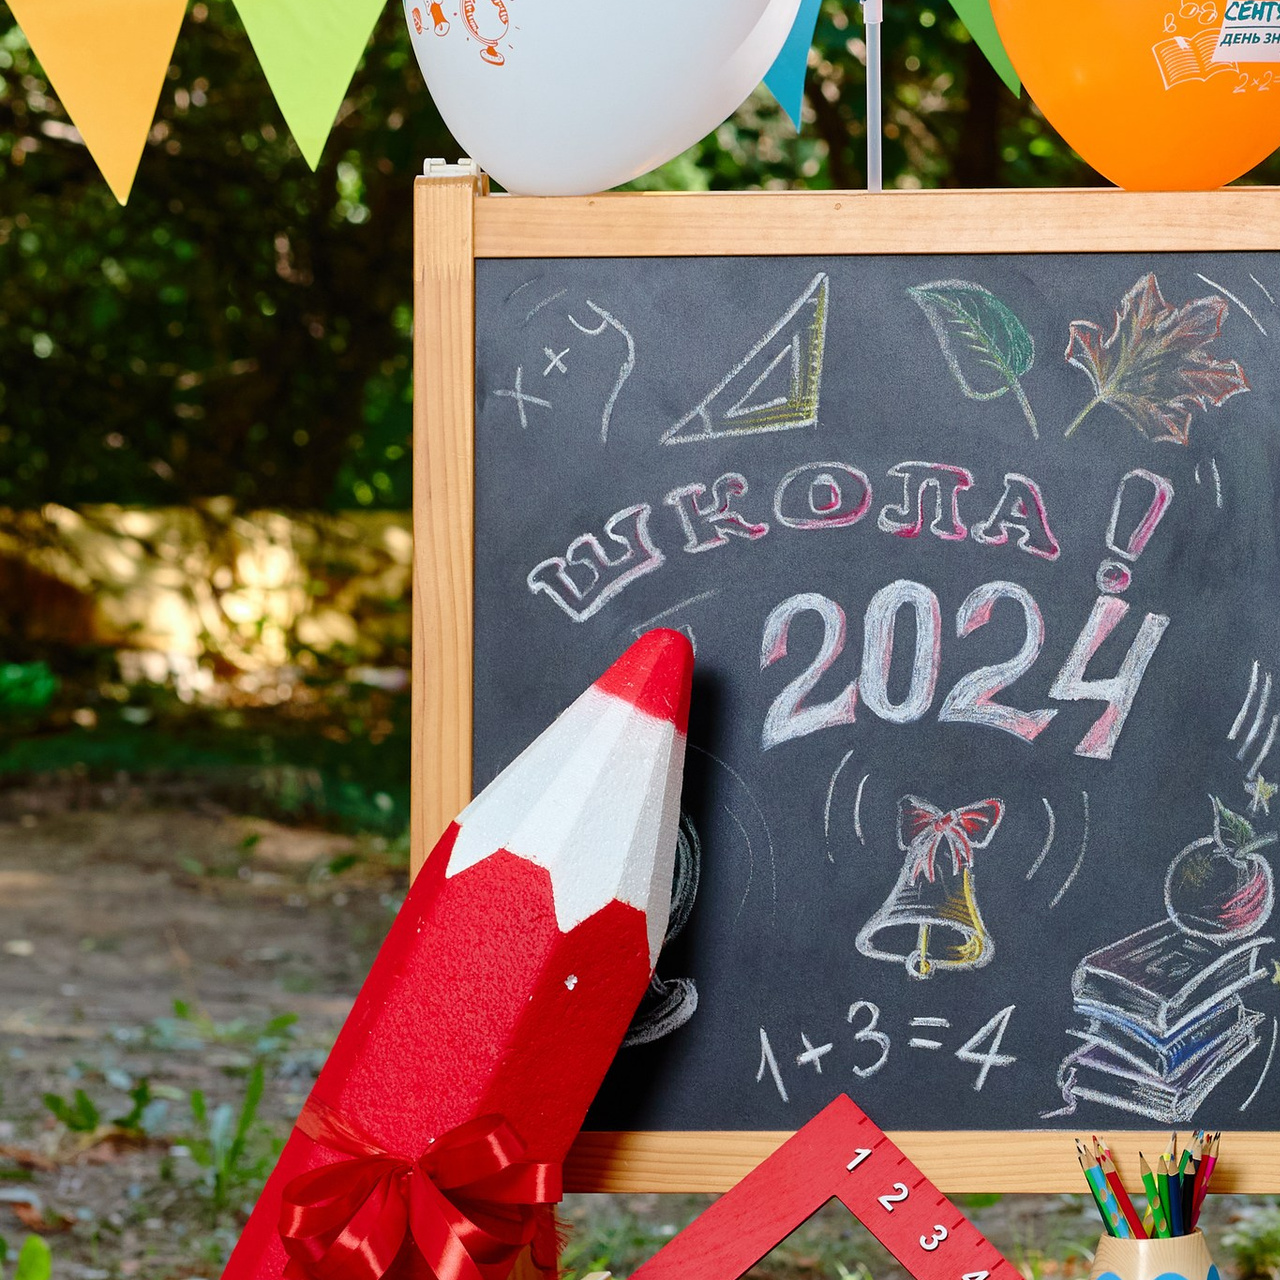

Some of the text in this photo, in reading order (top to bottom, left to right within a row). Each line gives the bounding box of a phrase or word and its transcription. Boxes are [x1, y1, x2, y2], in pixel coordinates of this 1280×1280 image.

[1219, 31, 1261, 48] ДЕНЬ
[760, 577, 1170, 761] 2024
[845, 1147, 872, 1173] 1
[877, 1182, 909, 1212] 2
[919, 1224, 948, 1251] 3
